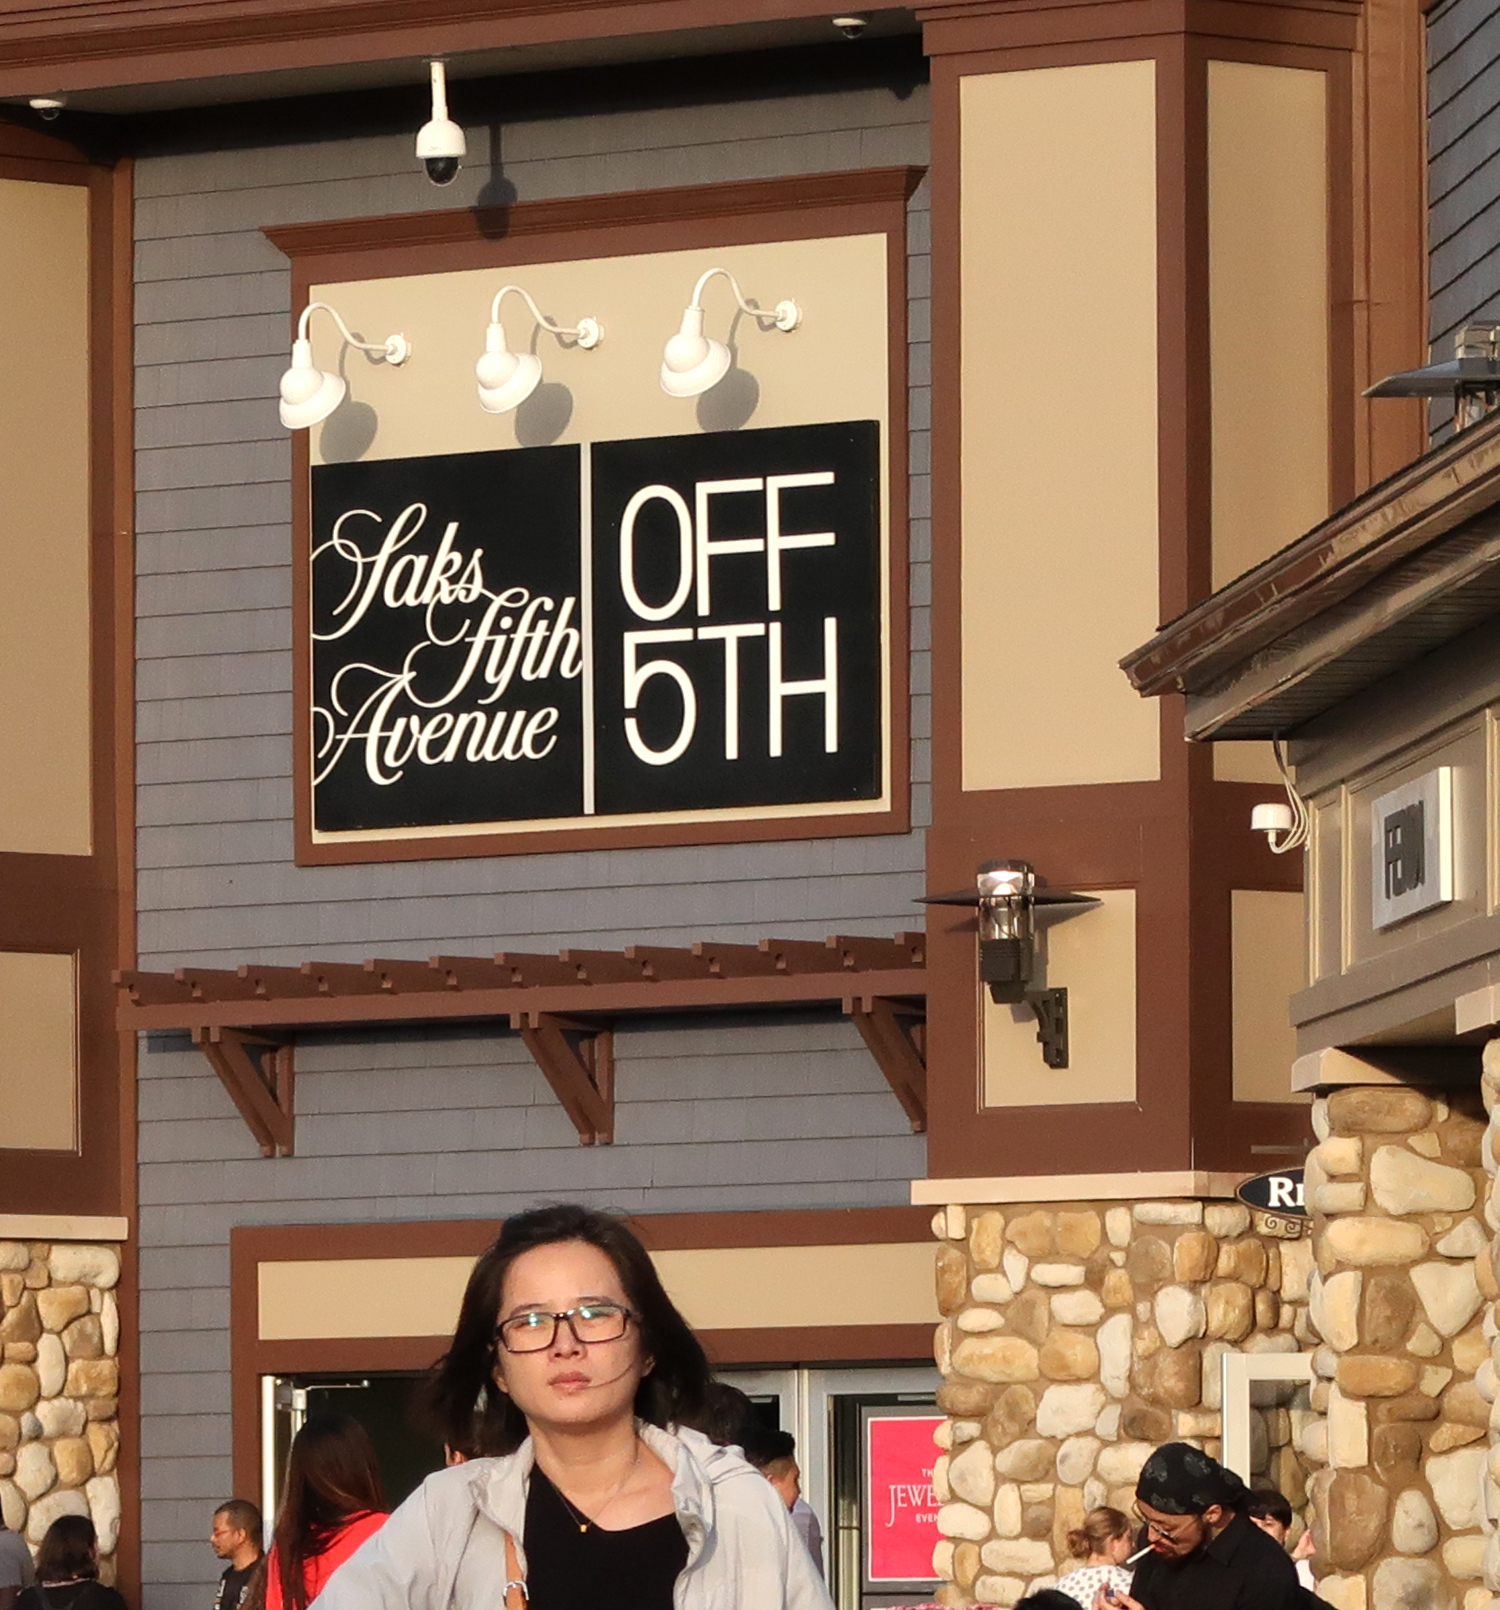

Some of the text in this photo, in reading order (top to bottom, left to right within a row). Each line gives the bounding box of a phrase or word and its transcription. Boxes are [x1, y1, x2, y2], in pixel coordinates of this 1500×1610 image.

[310, 502, 484, 640] Saks
[620, 471, 836, 621] OFF
[403, 583, 583, 708] Fifth
[623, 617, 838, 765] 5TH
[311, 663, 559, 785] Avenue
